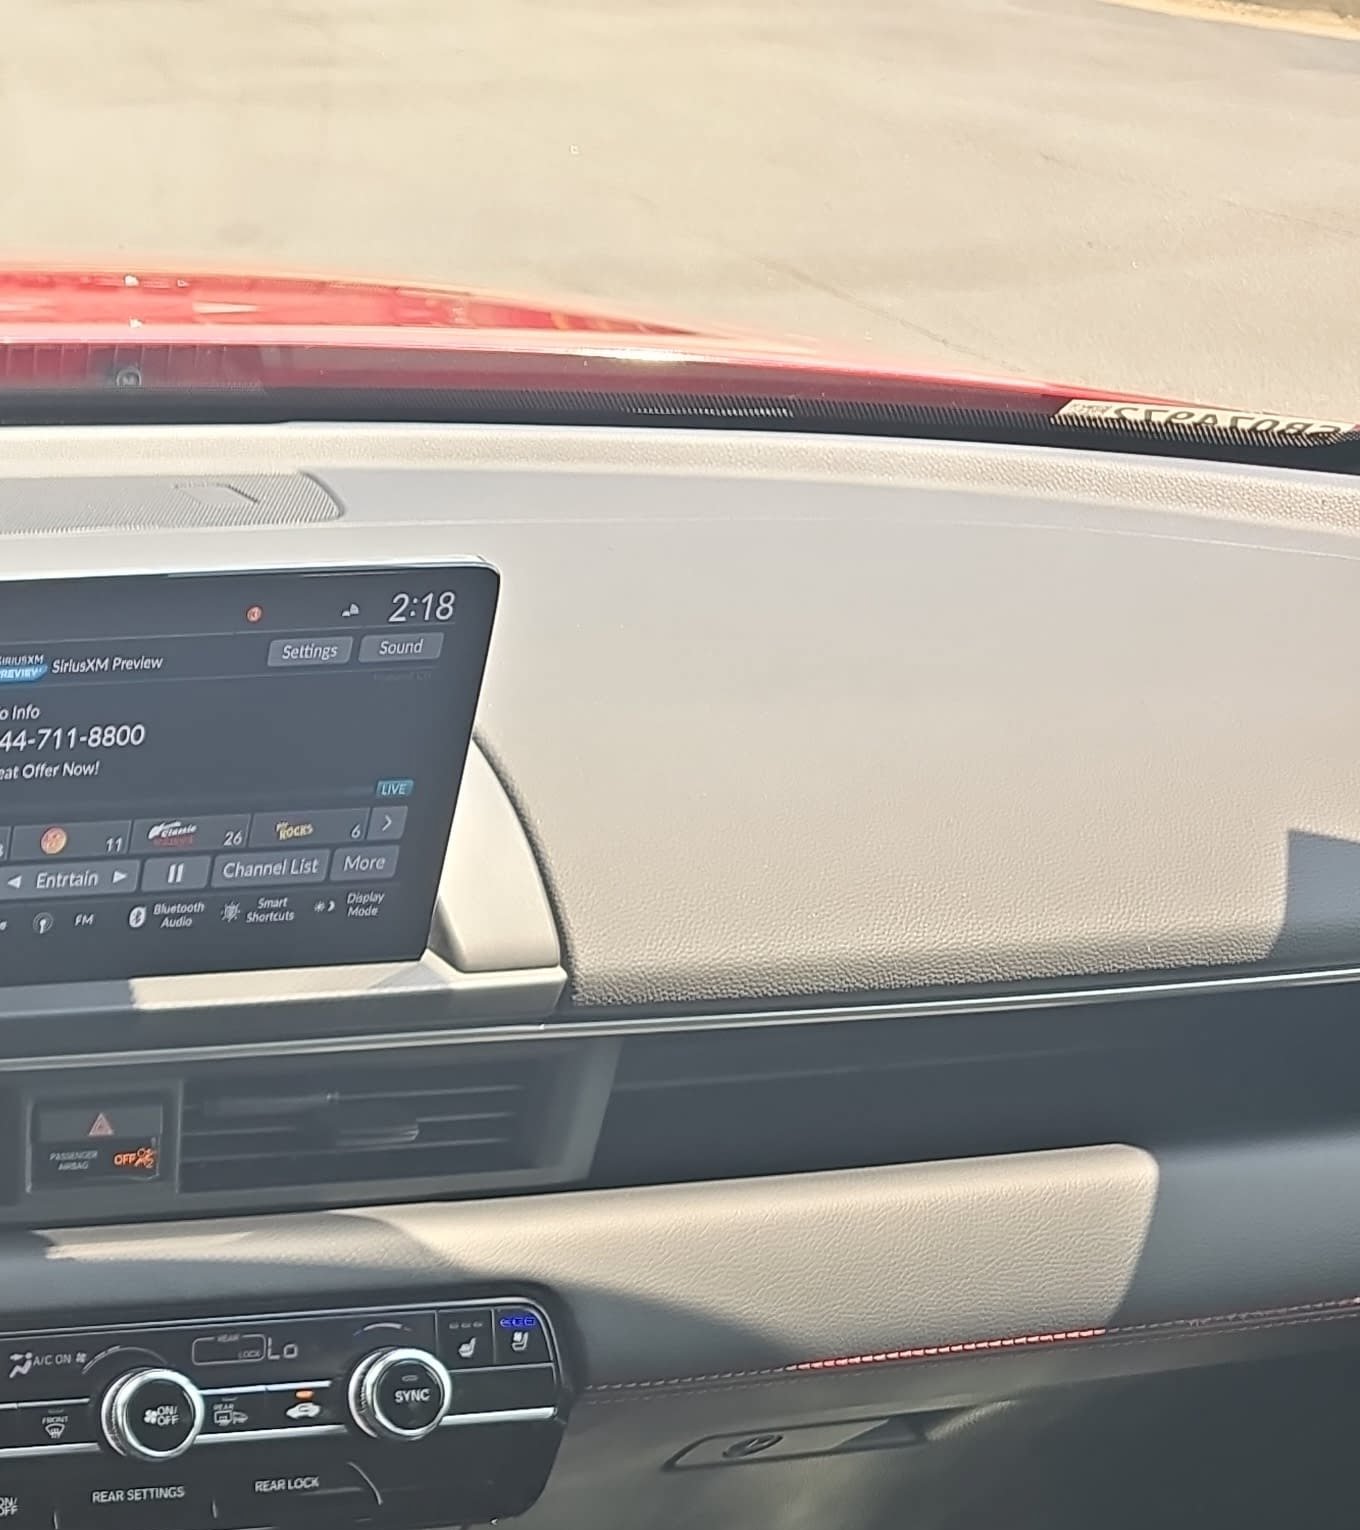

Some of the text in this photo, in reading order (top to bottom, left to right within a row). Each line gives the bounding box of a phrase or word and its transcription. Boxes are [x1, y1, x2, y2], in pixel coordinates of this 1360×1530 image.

[388, 591, 456, 623] 2:18
[281, 642, 339, 661] Settings
[379, 637, 424, 656] Sound
[52, 655, 163, 674] SiriusXM Preview
[11, 704, 40, 721] Info
[22, 762, 60, 780] Offer
[62, 760, 100, 778] Now!
[381, 782, 406, 796] LIVE
[223, 831, 243, 847] 26
[351, 824, 361, 839] 6
[105, 837, 122, 852] 11
[223, 857, 319, 879] Channel List
[343, 855, 385, 872] More
[36, 869, 99, 889] Entrtain
[257, 896, 288, 911] Smart
[346, 892, 385, 907] Display
[153, 900, 205, 916] Bluetooth
[245, 908, 295, 924] Shortcuts
[347, 904, 379, 918] Mode
[160, 914, 193, 929] Audio
[267, 1336, 298, 1360] Lo
[33, 1353, 72, 1367] A/C ON
[395, 1388, 430, 1402] SYNC
[157, 1406, 178, 1416] ON/
[157, 1415, 180, 1425] OFF
[255, 1476, 319, 1492] REAR LOCK
[92, 1486, 185, 1503] REAR SETTINGS
